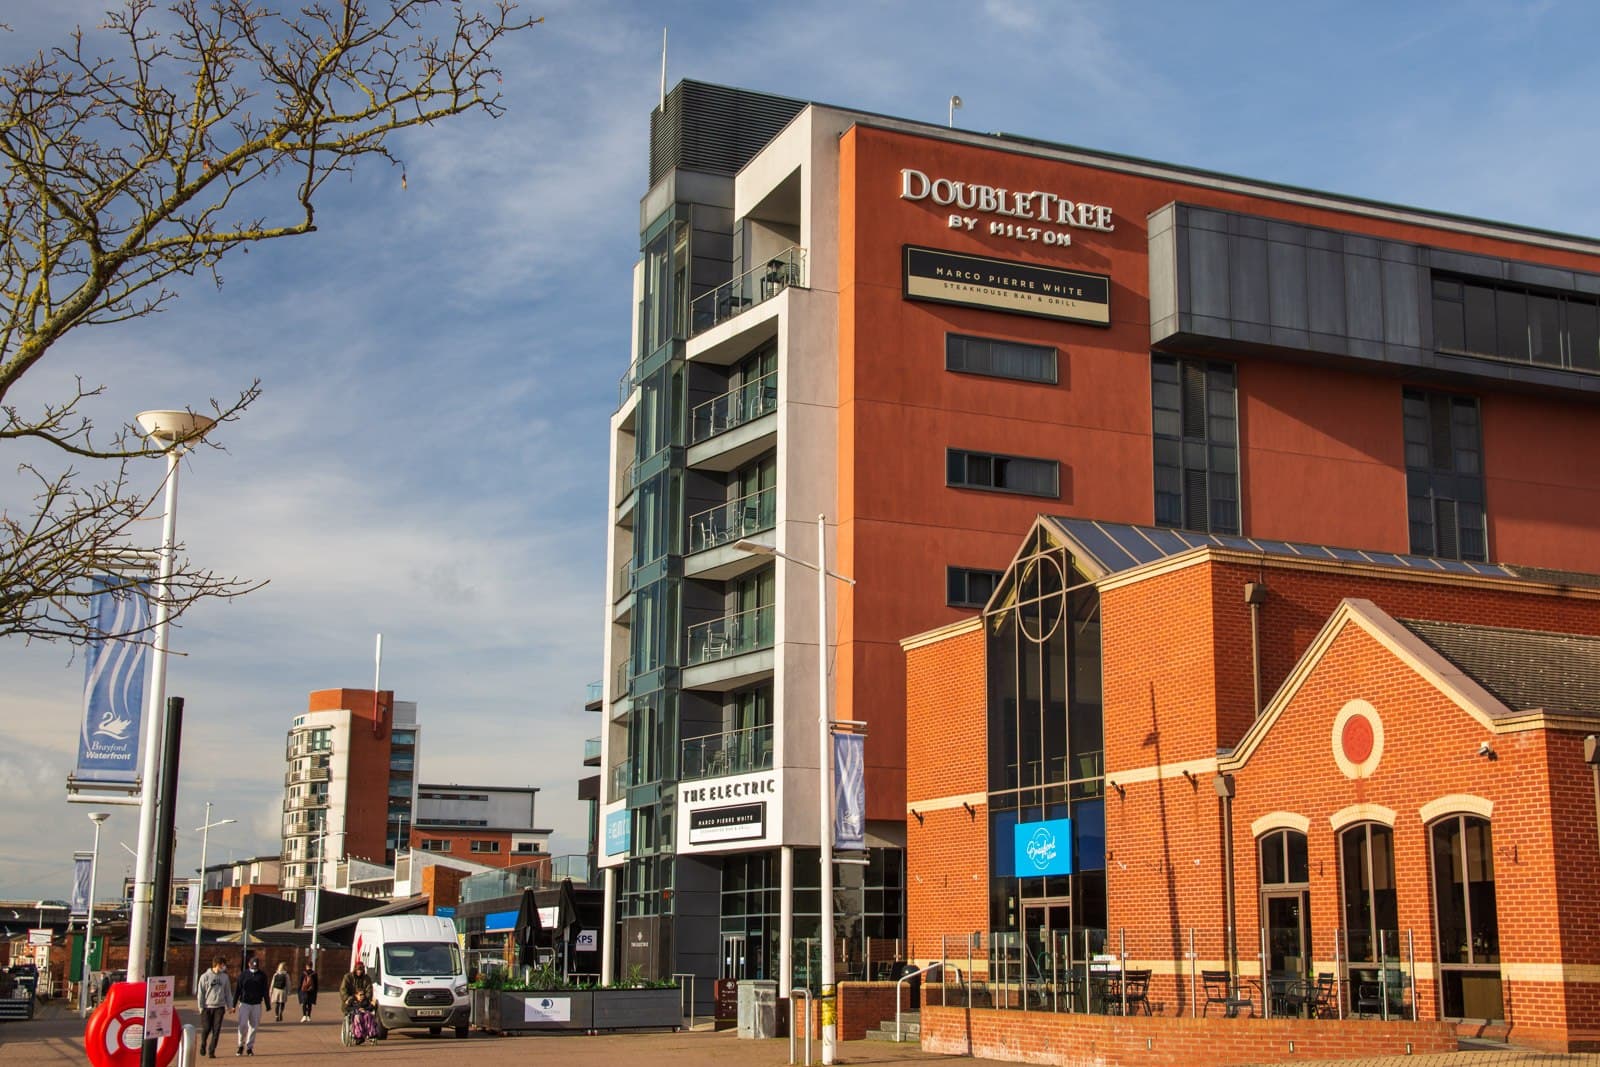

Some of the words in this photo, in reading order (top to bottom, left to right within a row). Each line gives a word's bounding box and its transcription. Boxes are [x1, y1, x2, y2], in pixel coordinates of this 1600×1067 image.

[948, 214, 978, 231] BY
[989, 221, 1072, 247] HILTON
[936, 267, 981, 282] MARCO
[988, 276, 1036, 290] PIERRE
[1042, 283, 1085, 297] WHITE
[943, 283, 1009, 298] STEAKHOUSE
[1013, 293, 1033, 301] BAR
[1047, 298, 1077, 308] GRILL
[86, 751, 131, 761] Waterfront
[91, 740, 128, 753] Brayford
[683, 788, 706, 803] THE
[710, 779, 775, 800] ELECTRIC
